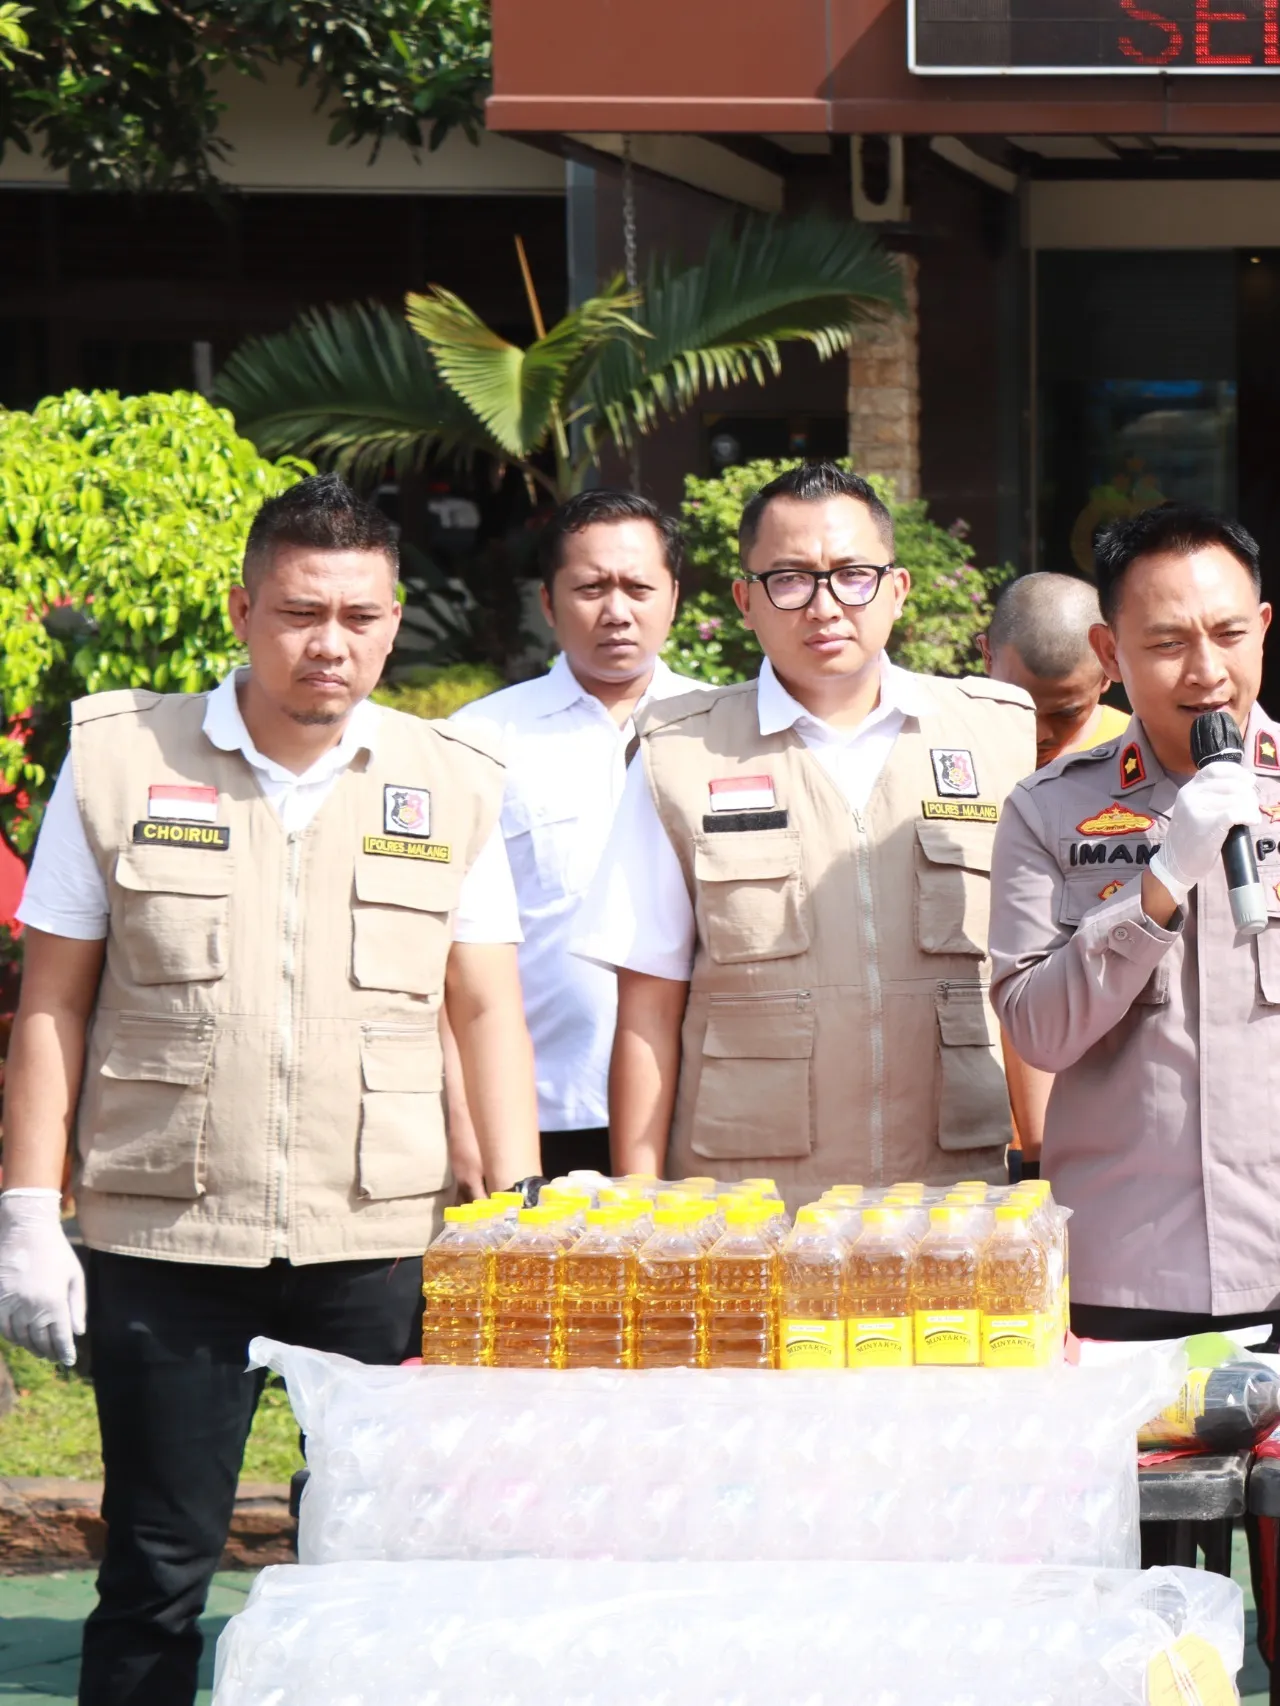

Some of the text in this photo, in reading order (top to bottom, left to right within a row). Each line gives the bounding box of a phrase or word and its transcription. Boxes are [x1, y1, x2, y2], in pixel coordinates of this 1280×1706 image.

[929, 803, 997, 819] POLRES MALANG
[143, 822, 224, 845] CHOIRUL
[369, 838, 448, 859] POLRES MALANG
